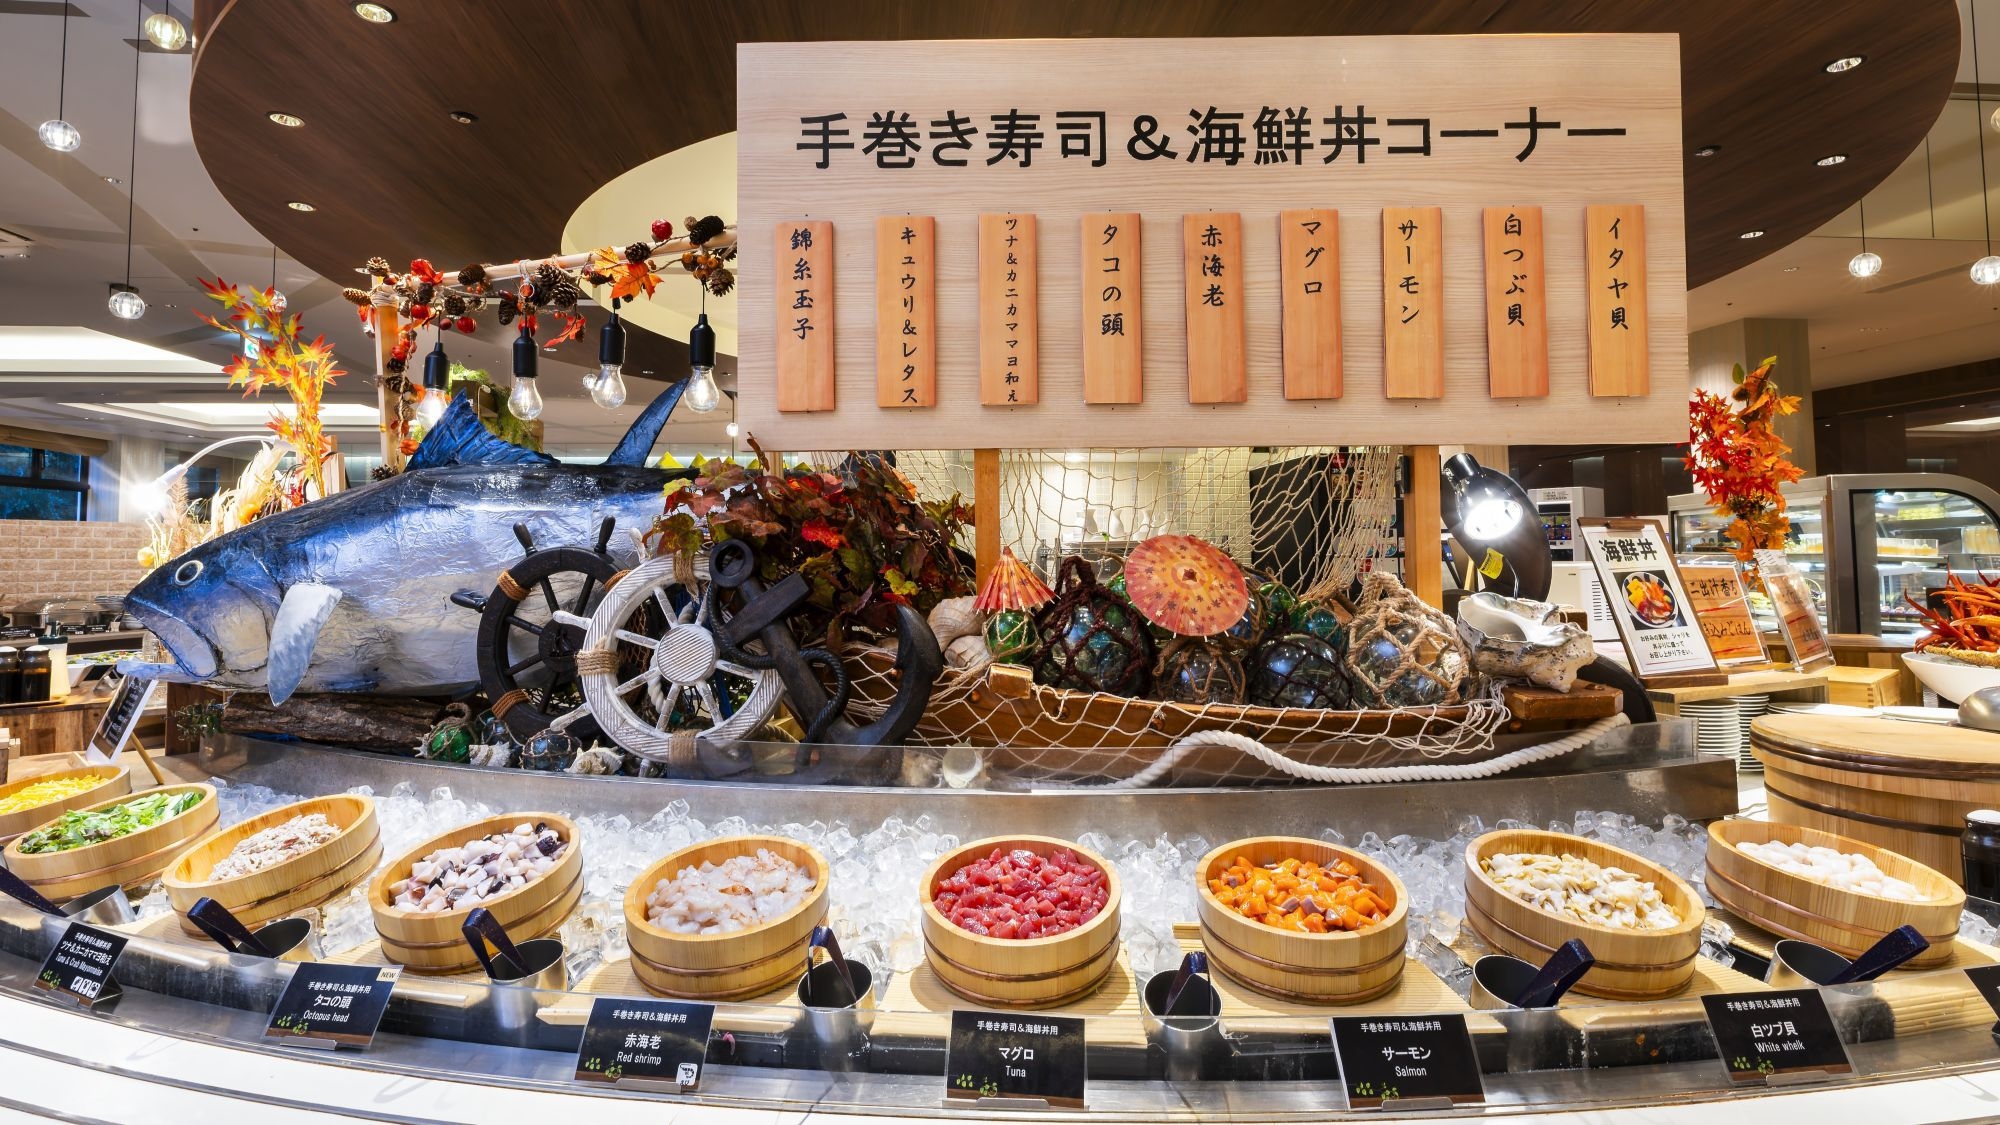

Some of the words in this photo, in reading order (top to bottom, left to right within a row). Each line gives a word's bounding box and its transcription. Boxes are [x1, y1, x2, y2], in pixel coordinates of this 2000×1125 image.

[796, 106, 1628, 169] 手巻き寿司&海鮮丼コーナー
[1201, 225, 1224, 307] 赤海老
[1301, 220, 1325, 294] マグロ
[1101, 224, 1125, 336] タコの頭
[1398, 219, 1419, 324] サーモン
[1503, 213, 1527, 327] 白つぶ貝
[1607, 218, 1628, 330] イタヤ貝
[790, 228, 814, 340] 錦糸玉子
[900, 227, 918, 404] キュウリ&レタス
[1004, 218, 1019, 402] ツナ&カニカママヨ和え
[1599, 538, 1657, 562] 海鮮丼
[313, 994, 353, 1009] タコの頭
[303, 1010, 331, 1021] Octopus
[332, 1013, 350, 1022] head
[625, 1033, 661, 1049] 赤海老
[1750, 1021, 1799, 1038] 白ツブ貝
[999, 1046, 1034, 1061] マグロ
[1381, 1046, 1432, 1061] サーモン
[1755, 1041, 1780, 1053] White
[1782, 1039, 1806, 1052] whelk
[617, 1052, 632, 1063] Red
[634, 1053, 661, 1065] shrimp
[1005, 1065, 1026, 1078] Tuna
[1395, 1065, 1427, 1077] Salmon
